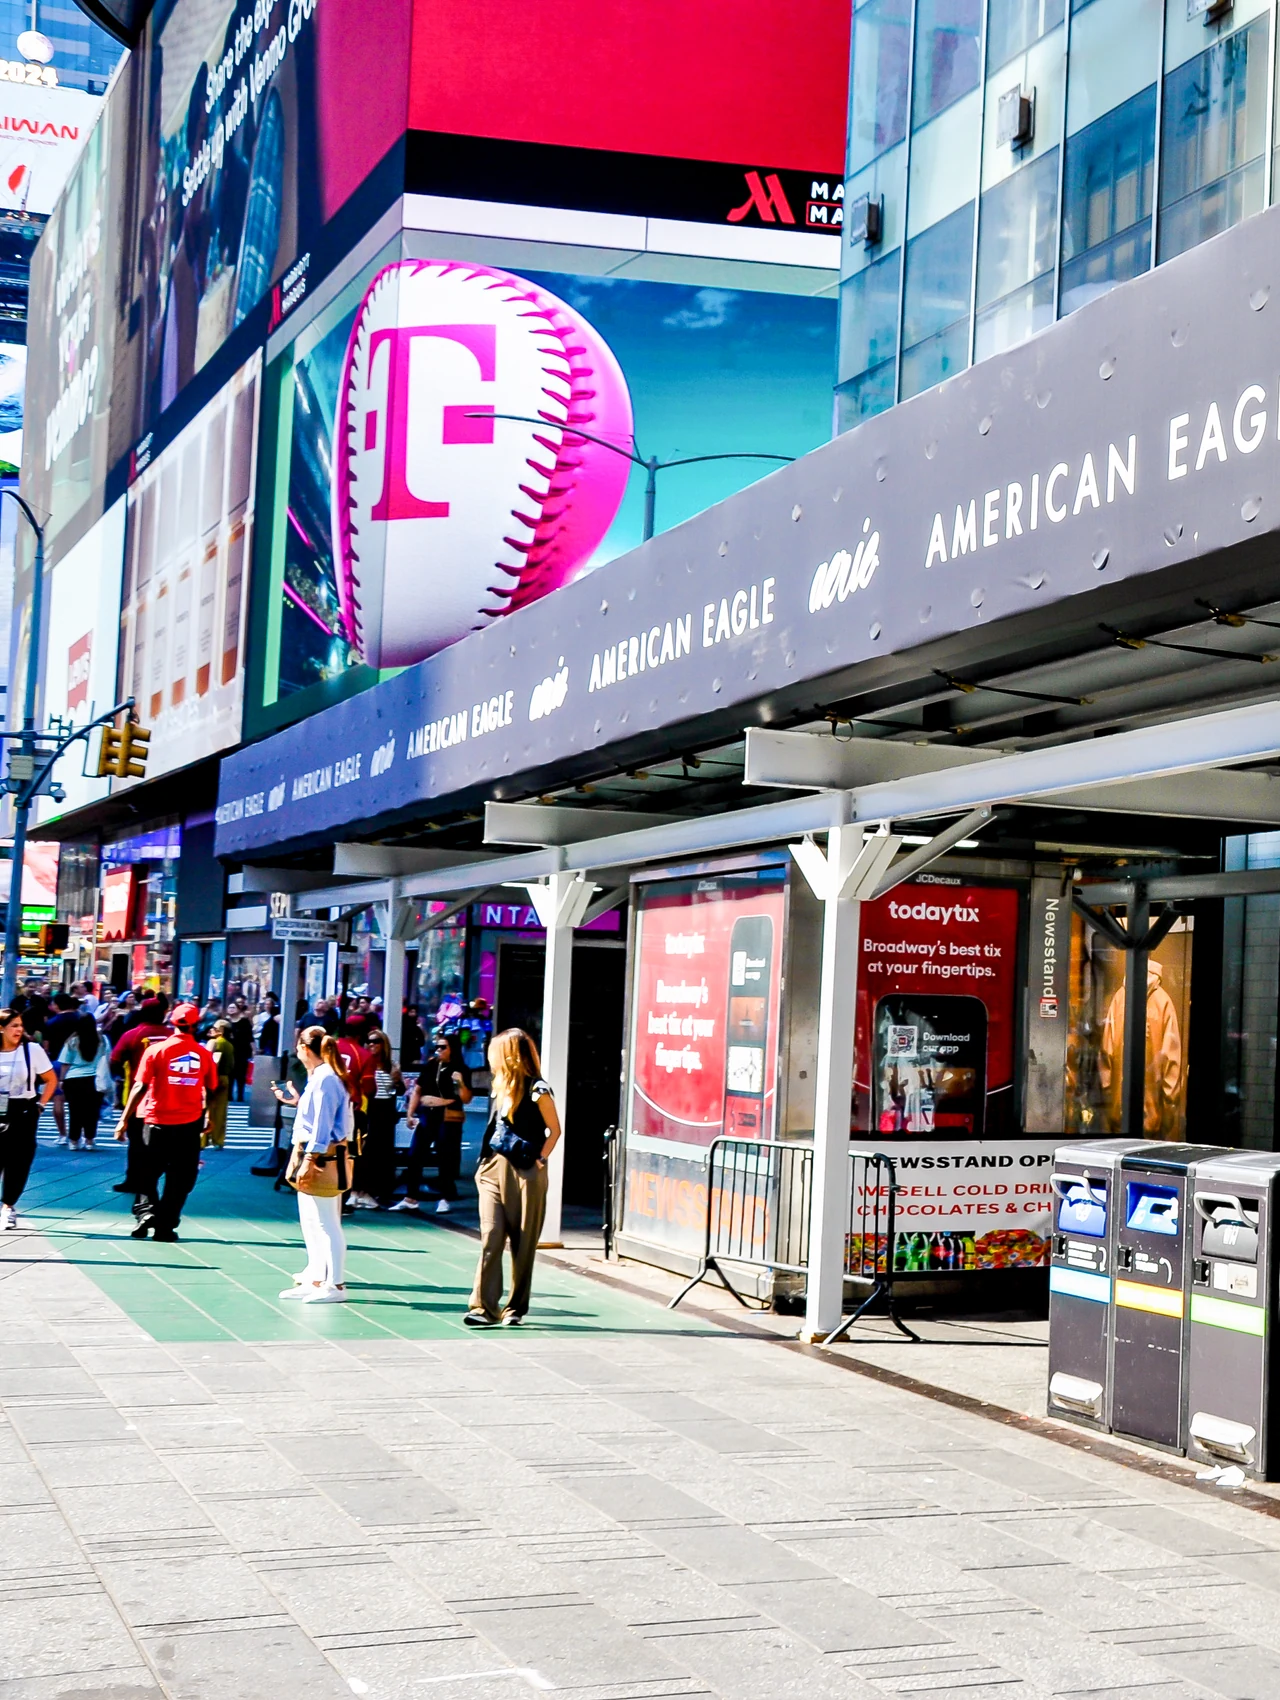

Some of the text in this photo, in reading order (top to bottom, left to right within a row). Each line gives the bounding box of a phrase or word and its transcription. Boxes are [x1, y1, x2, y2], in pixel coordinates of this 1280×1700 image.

[407, 710, 468, 760] AMERICAN
[471, 690, 515, 738] EAGLE
[588, 613, 692, 693] AMERICAN
[702, 577, 775, 648] EAGLE
[925, 434, 1137, 568] AMERICAN
[915, 874, 961, 885] JCDecaux
[888, 900, 980, 925] todaytix
[864, 938, 1002, 957] Broadway's best tix
[1042, 898, 1060, 998] Newsstand
[867, 960, 996, 979] at your fingertips.
[922, 1032, 971, 1042] Download
[866, 1155, 1055, 1169] NEWSSTAND OP
[858, 1183, 1054, 1196] WE SELL COLD DRI
[857, 1203, 1000, 1216] CHOCOLATES
[1005, 1205, 1018, 1213] &
